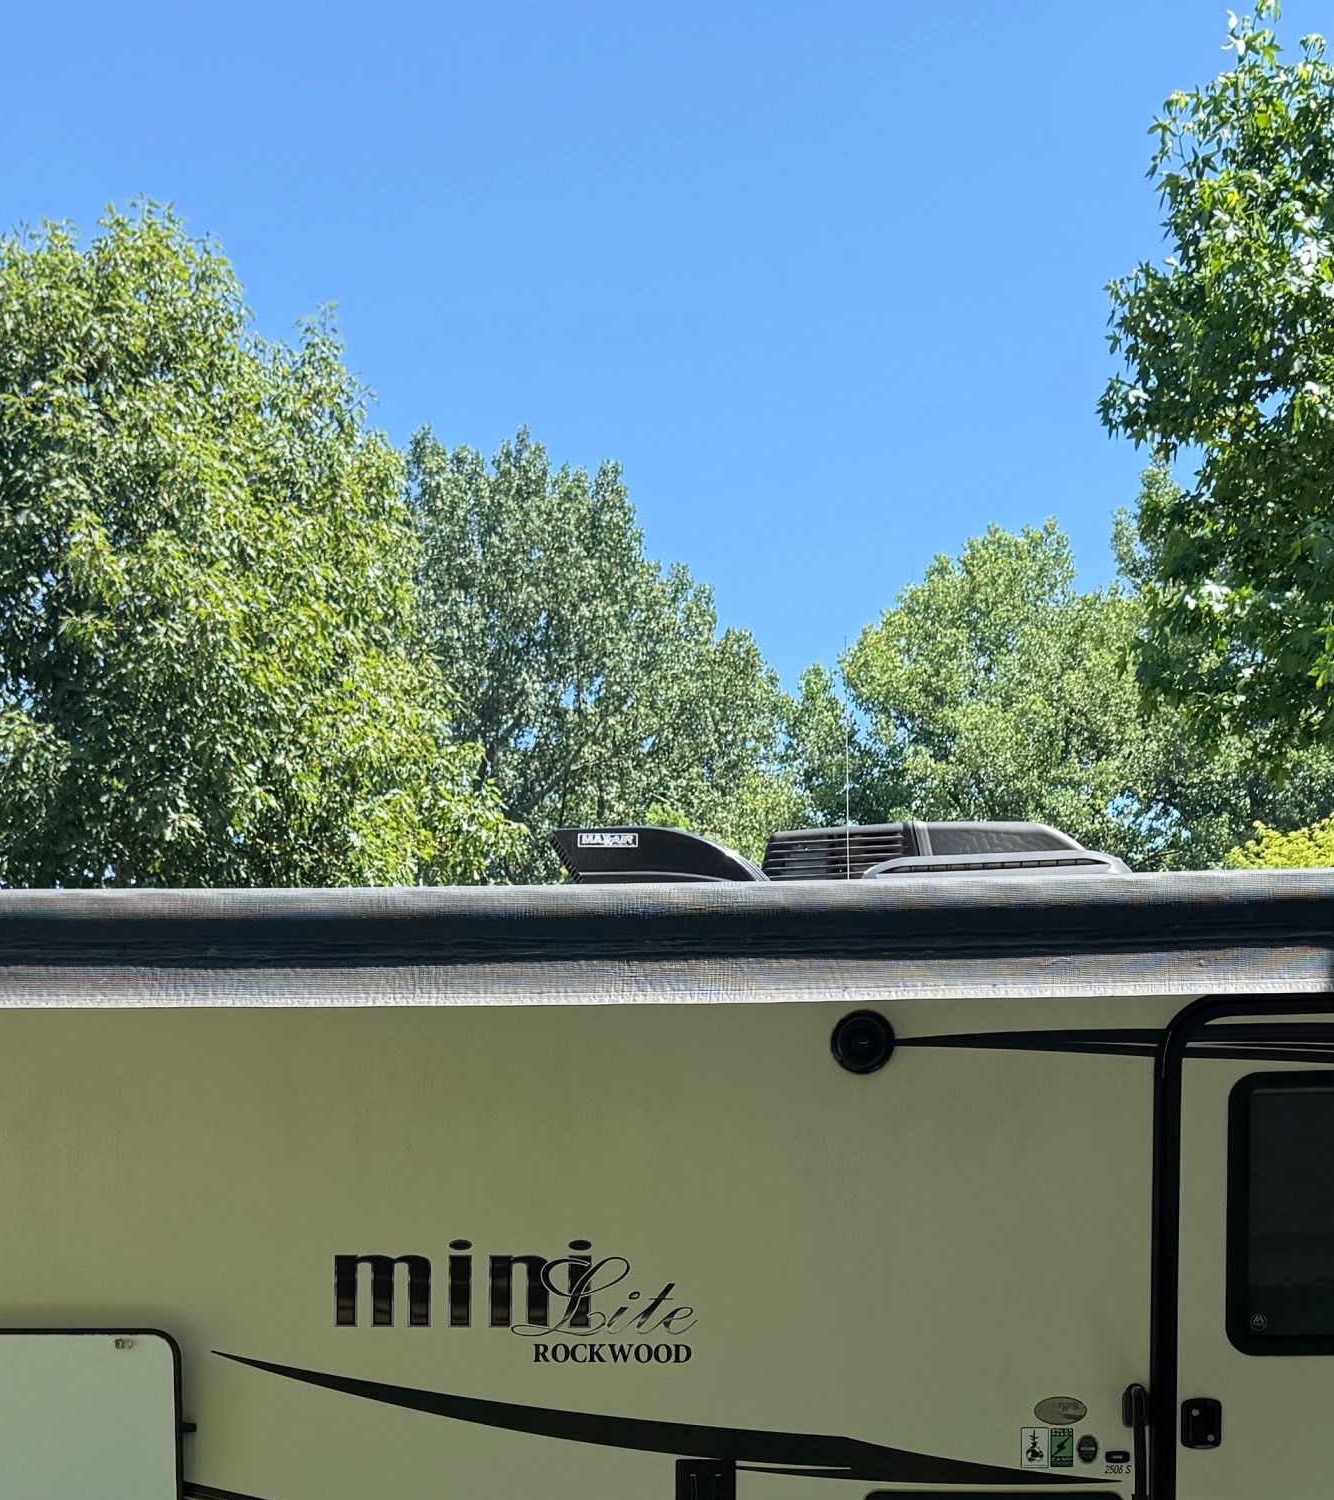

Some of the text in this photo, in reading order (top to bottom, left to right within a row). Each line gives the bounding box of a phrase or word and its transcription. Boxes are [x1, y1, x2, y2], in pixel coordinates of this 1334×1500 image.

[334, 1239, 698, 1337] mini Lite
[532, 1343, 693, 1363] ROCKWOOD
